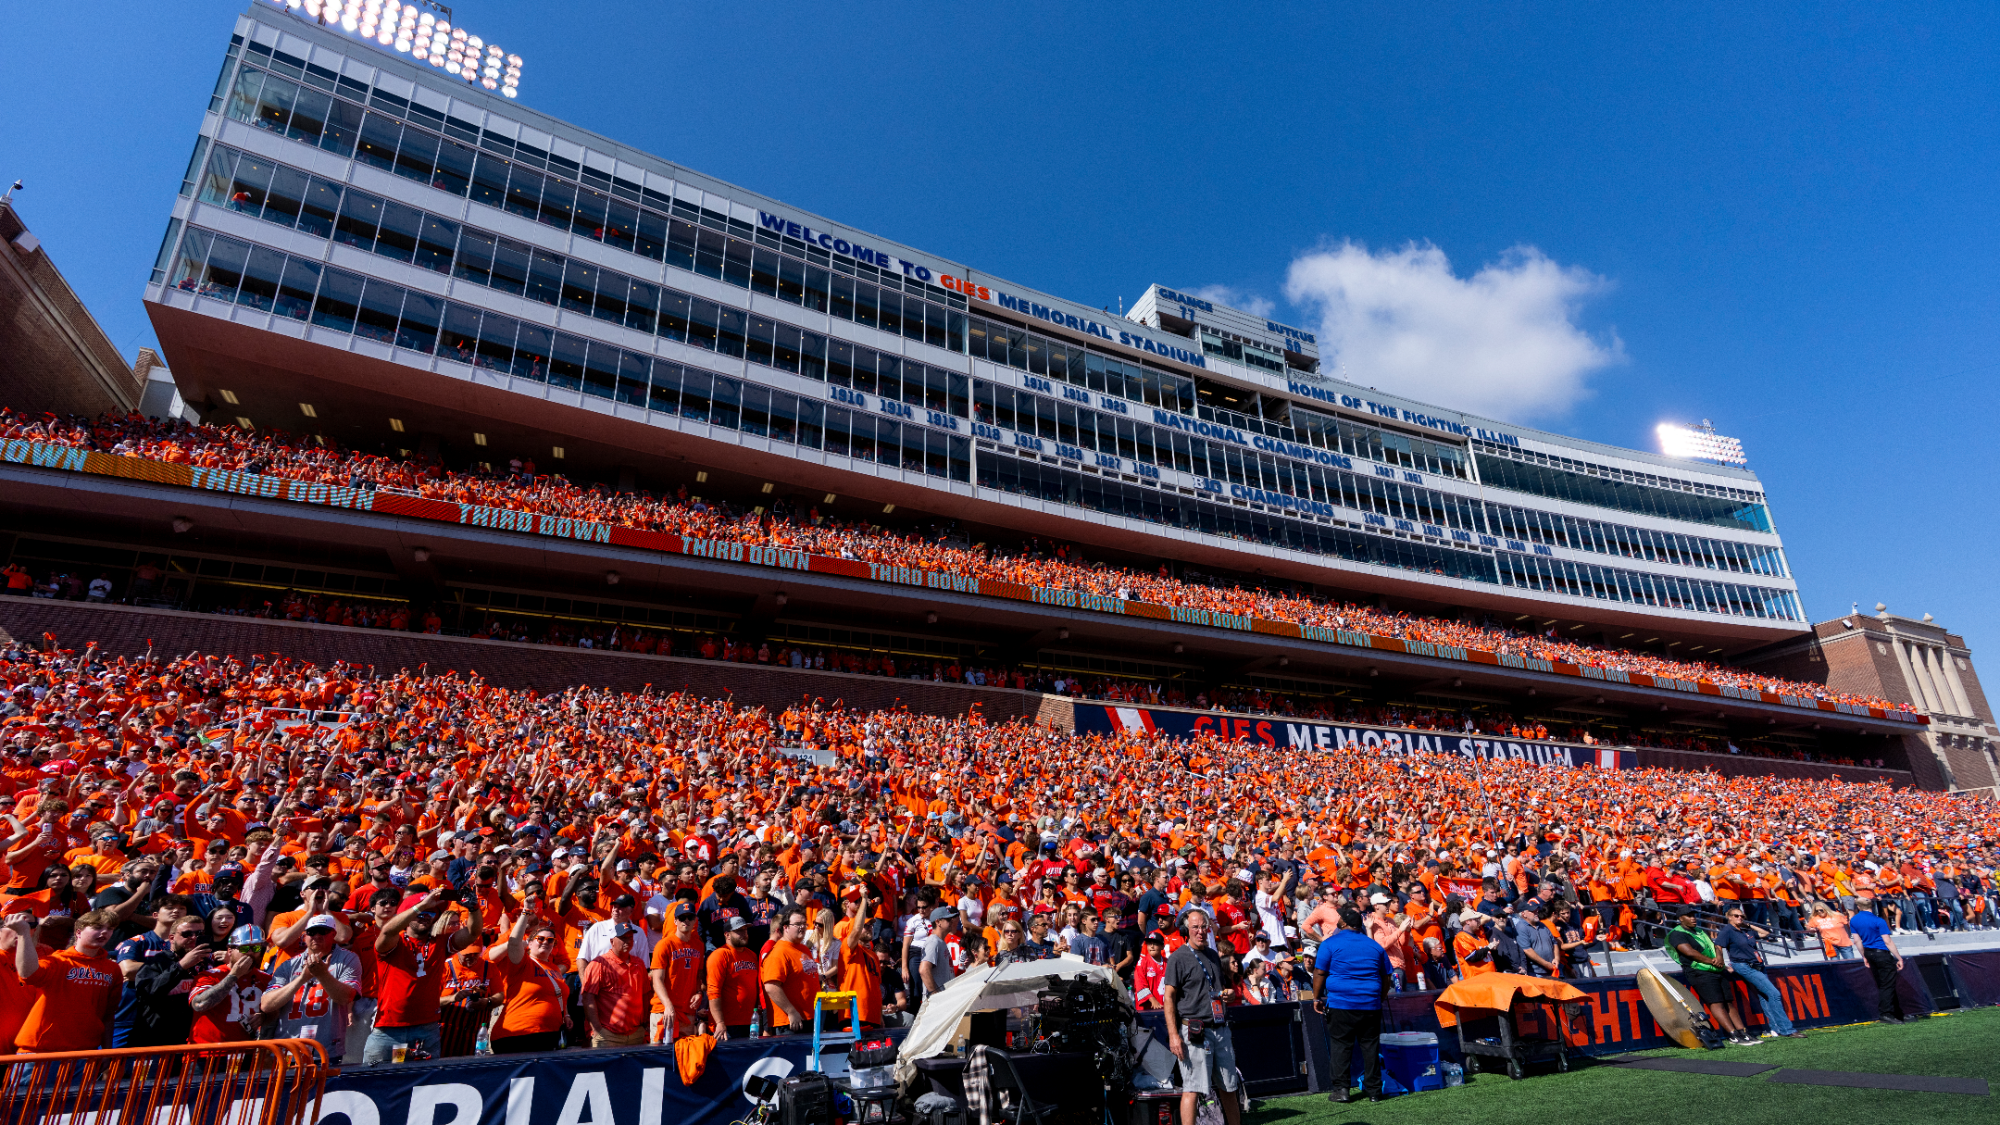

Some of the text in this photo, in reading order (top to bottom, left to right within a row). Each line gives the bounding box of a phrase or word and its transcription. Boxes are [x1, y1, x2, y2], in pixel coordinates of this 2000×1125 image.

[760, 211, 1206, 368] WELCOME TO GIES MEMORIAL STADIUM
[1159, 287, 1213, 313] GRANGE
[1180, 305, 1195, 322] 77
[1267, 321, 1315, 344] BUTKUS
[1023, 374, 1051, 393] 1914
[1153, 409, 1248, 445] NATIONAL
[1253, 435, 1352, 469] CHAMPIONS
[1288, 380, 1520, 447] HOME OF THE FIGHTING ILLINI
[0, 439, 88, 472] OWN
[831, 386, 865, 407] 1910
[880, 399, 912, 419] 1914
[926, 411, 958, 430] 1915
[971, 423, 1000, 441] 1918
[1014, 433, 1043, 451] 1919
[1055, 443, 1083, 461] 1923
[1095, 453, 1122, 470] 1927
[1132, 461, 1159, 479] 1928
[1230, 484, 1334, 517] CHAMPIONS
[191, 466, 375, 511] THIRD DOWN
[458, 503, 612, 543] THIRD DOWN
[681, 536, 810, 571] THIRD DOWN
[869, 563, 979, 594] THIRD DOWN
[1031, 586, 1125, 614] THIRD DOWN
[1169, 606, 1251, 631] THIRD DOWN
[1299, 624, 1372, 648] THIRD DOWN
[1403, 640, 1468, 661] THIRD DOWN
[1495, 653, 1553, 673] THIRD DOWN
[1578, 665, 1630, 684] THIRD DOWN
[1652, 676, 1699, 694] THIRD DOWN
[1193, 716, 1574, 770] GIES MEMORIAL STADIUM
[698, 844, 710, 861] 4
